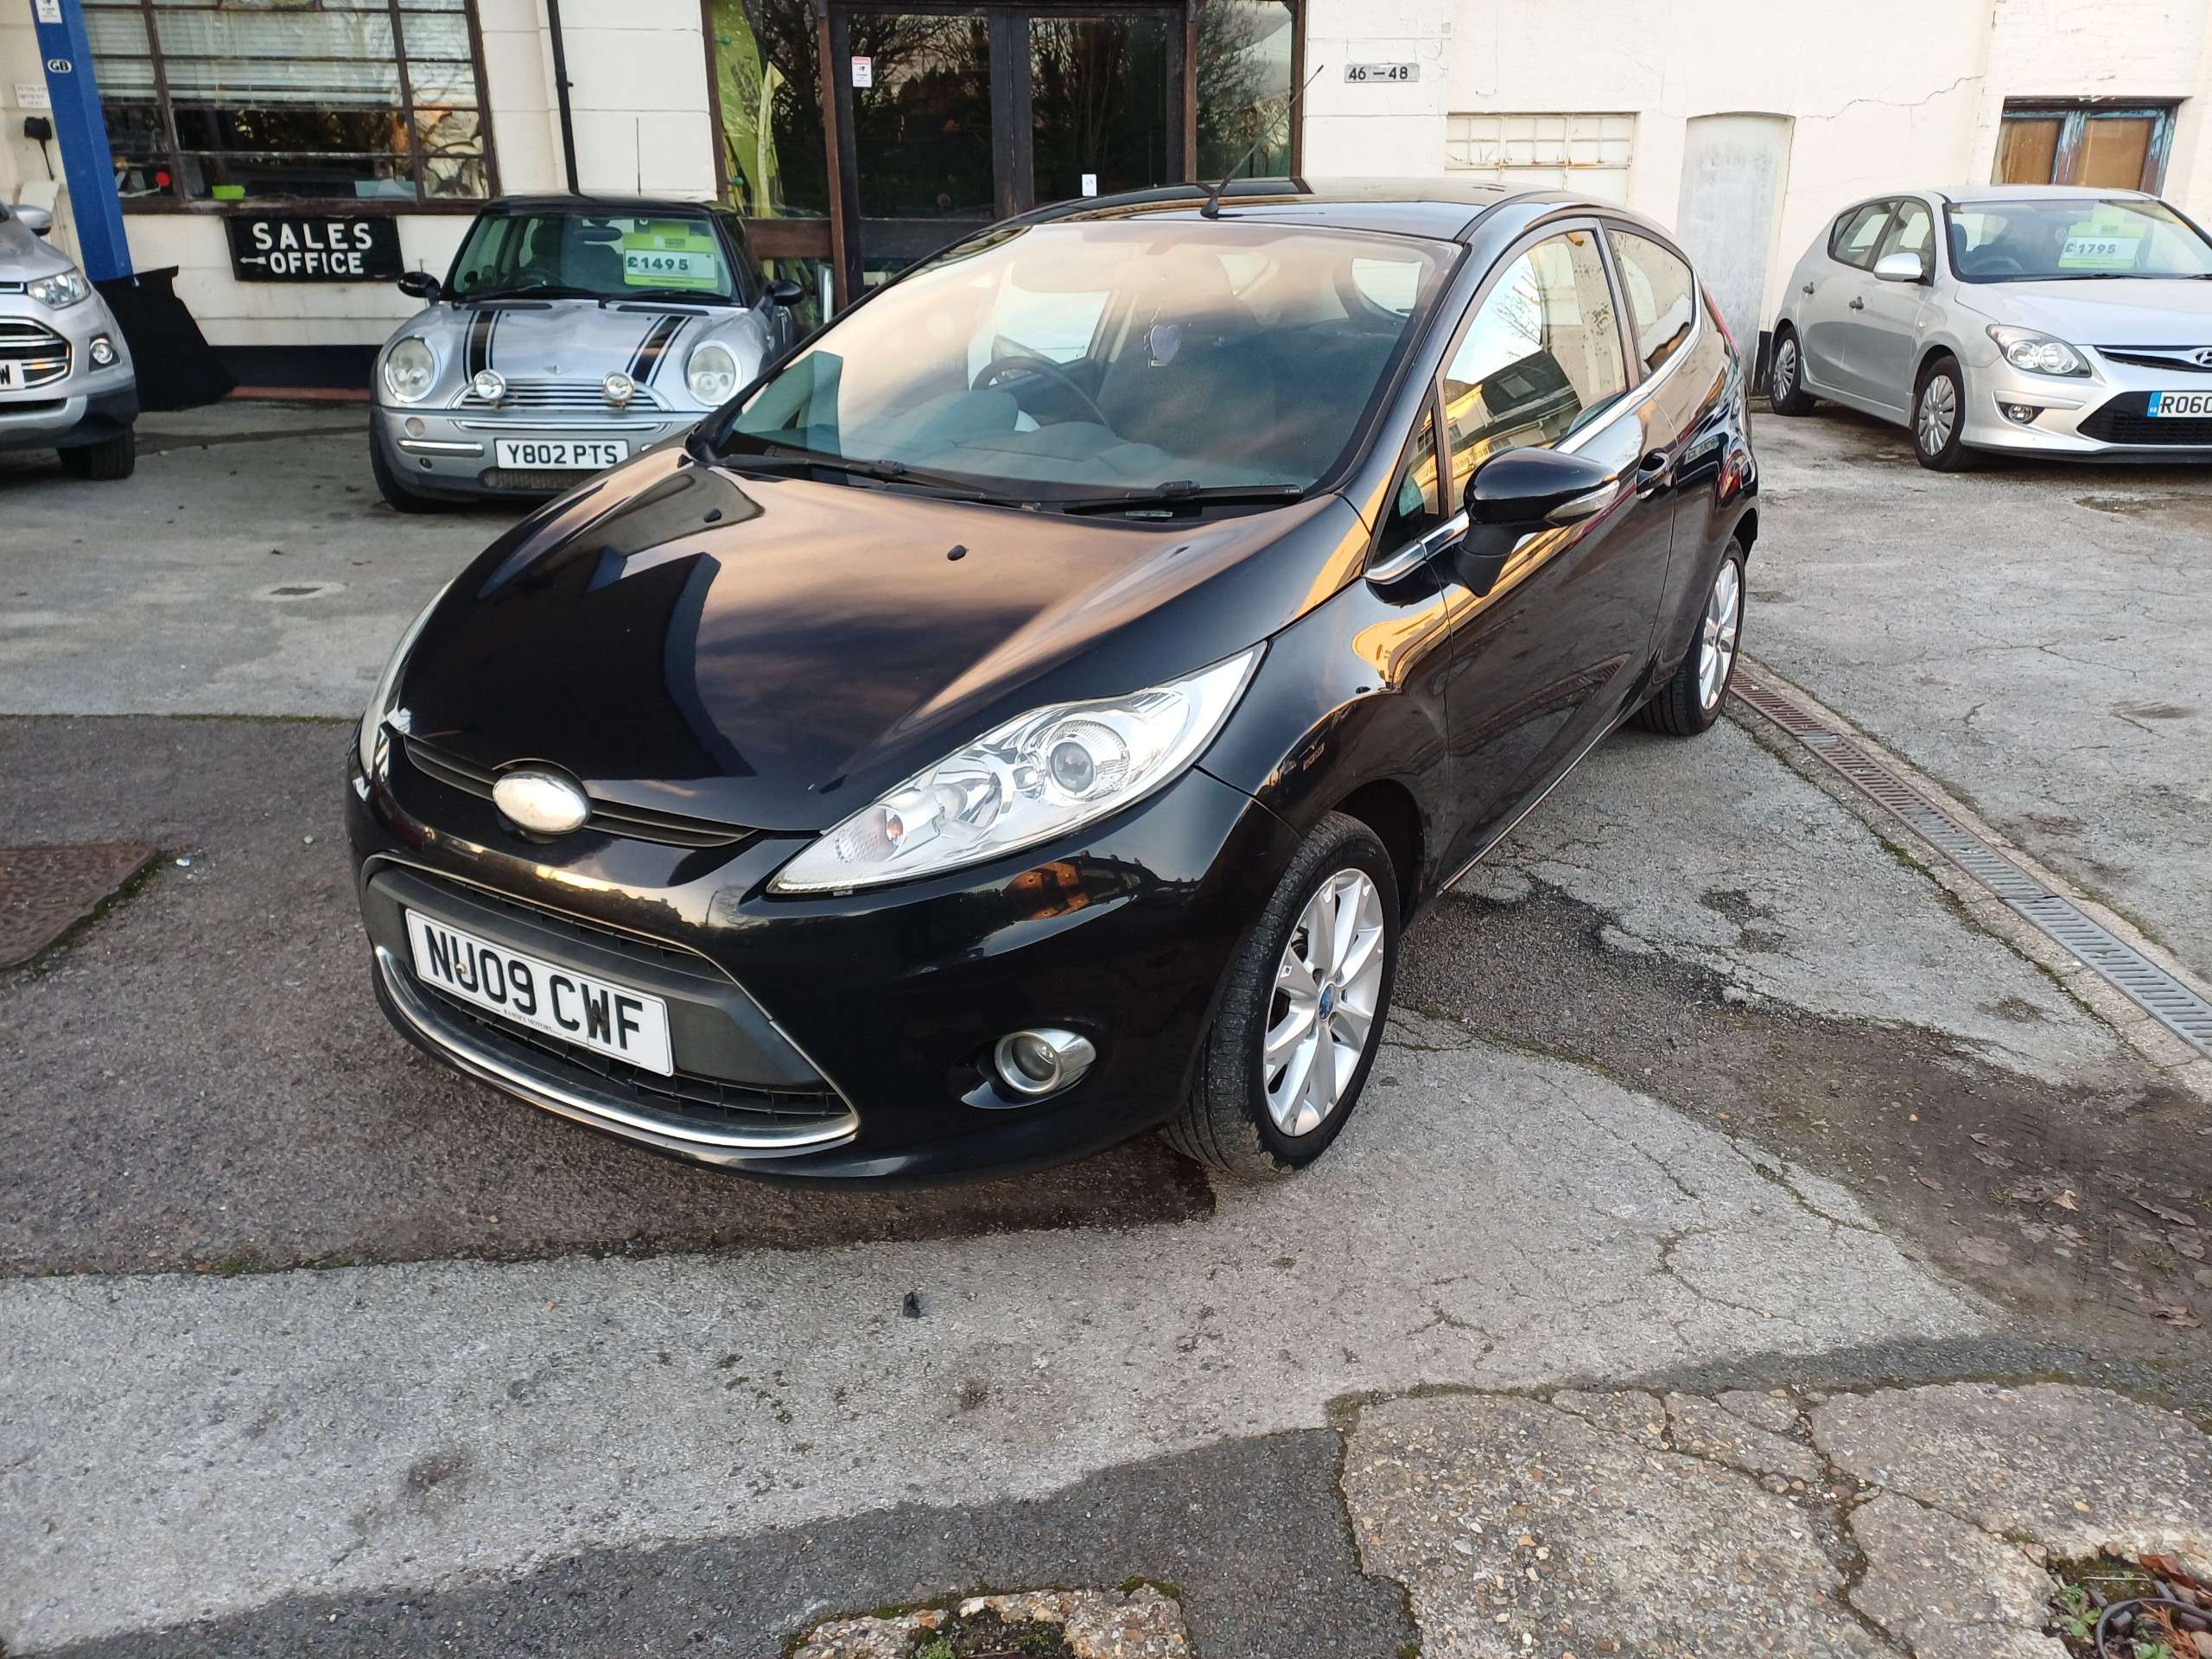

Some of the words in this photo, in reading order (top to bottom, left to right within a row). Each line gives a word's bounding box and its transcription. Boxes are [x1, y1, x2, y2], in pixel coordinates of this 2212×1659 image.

[49, 60, 69, 71] GB
[252, 222, 372, 251] SALES
[2064, 243, 2116, 254] £1795
[270, 251, 364, 275] OFFICE
[627, 257, 689, 271] £1495
[507, 444, 567, 465] Y802
[573, 445, 617, 464] PTS
[424, 925, 537, 1016] NU09
[550, 975, 644, 1051] CWF
